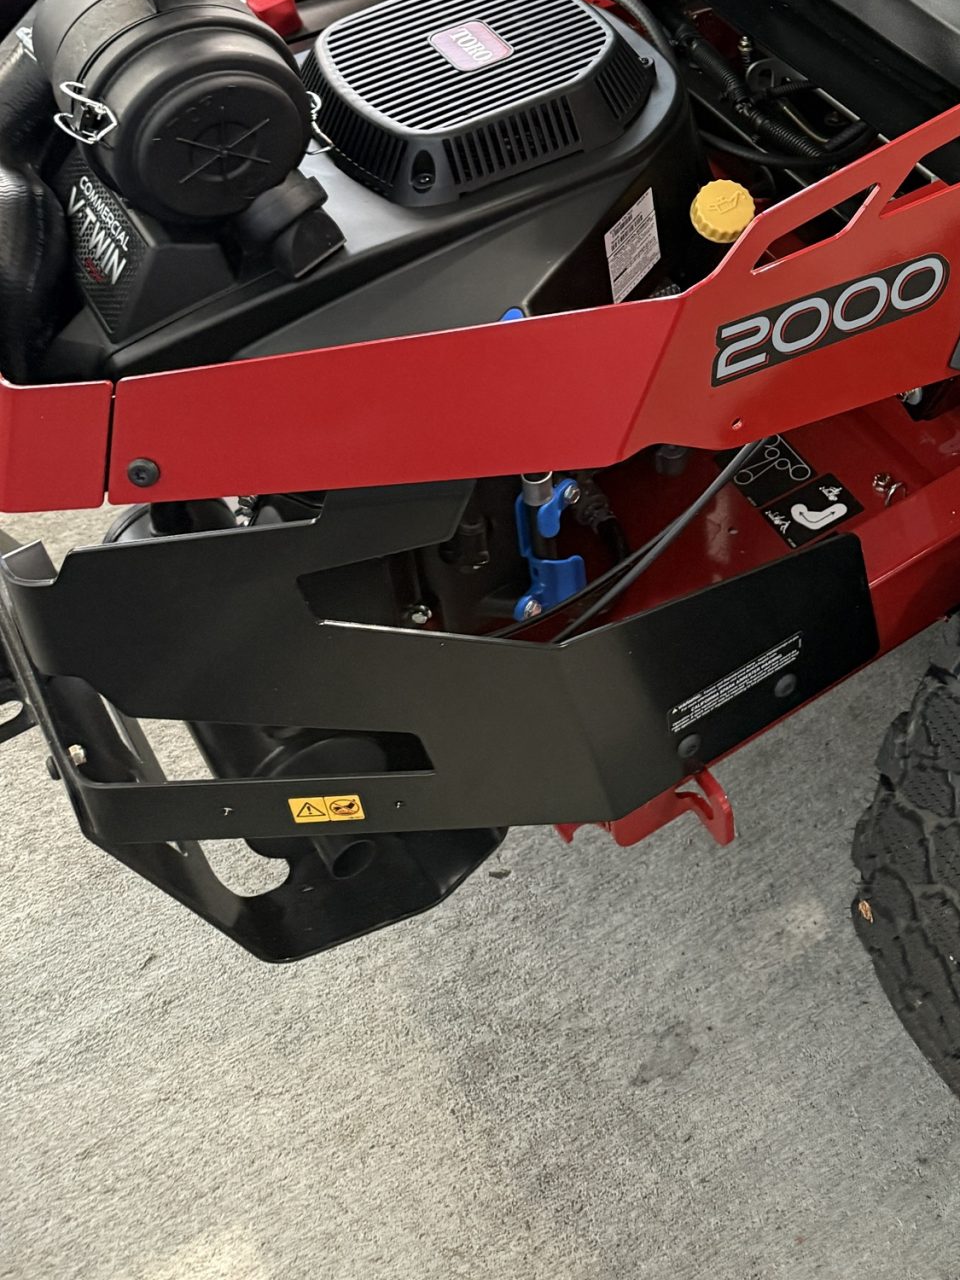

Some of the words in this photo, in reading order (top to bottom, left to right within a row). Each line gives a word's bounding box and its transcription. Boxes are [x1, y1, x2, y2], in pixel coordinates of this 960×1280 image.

[449, 27, 494, 62] TORO
[80, 175, 130, 252] COMMERCIAL
[716, 256, 945, 380] 2000
